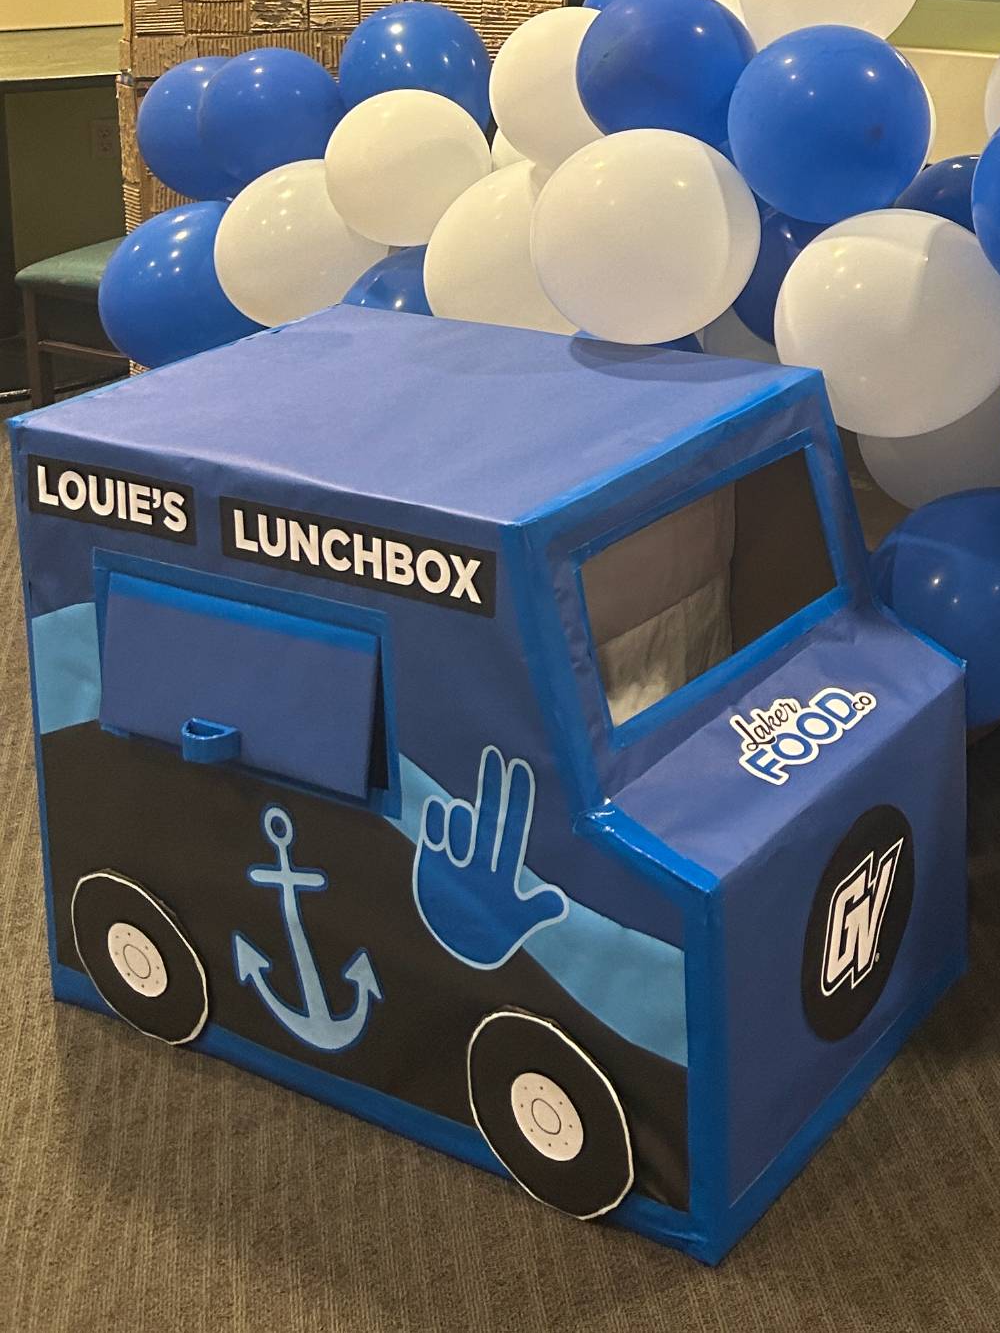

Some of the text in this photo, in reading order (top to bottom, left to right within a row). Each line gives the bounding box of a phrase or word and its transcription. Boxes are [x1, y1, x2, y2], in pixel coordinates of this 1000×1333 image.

[37, 465, 482, 604] LOUIE'S LUNCHBOX
[734, 700, 799, 751] Laker
[745, 691, 858, 781] FOOD
